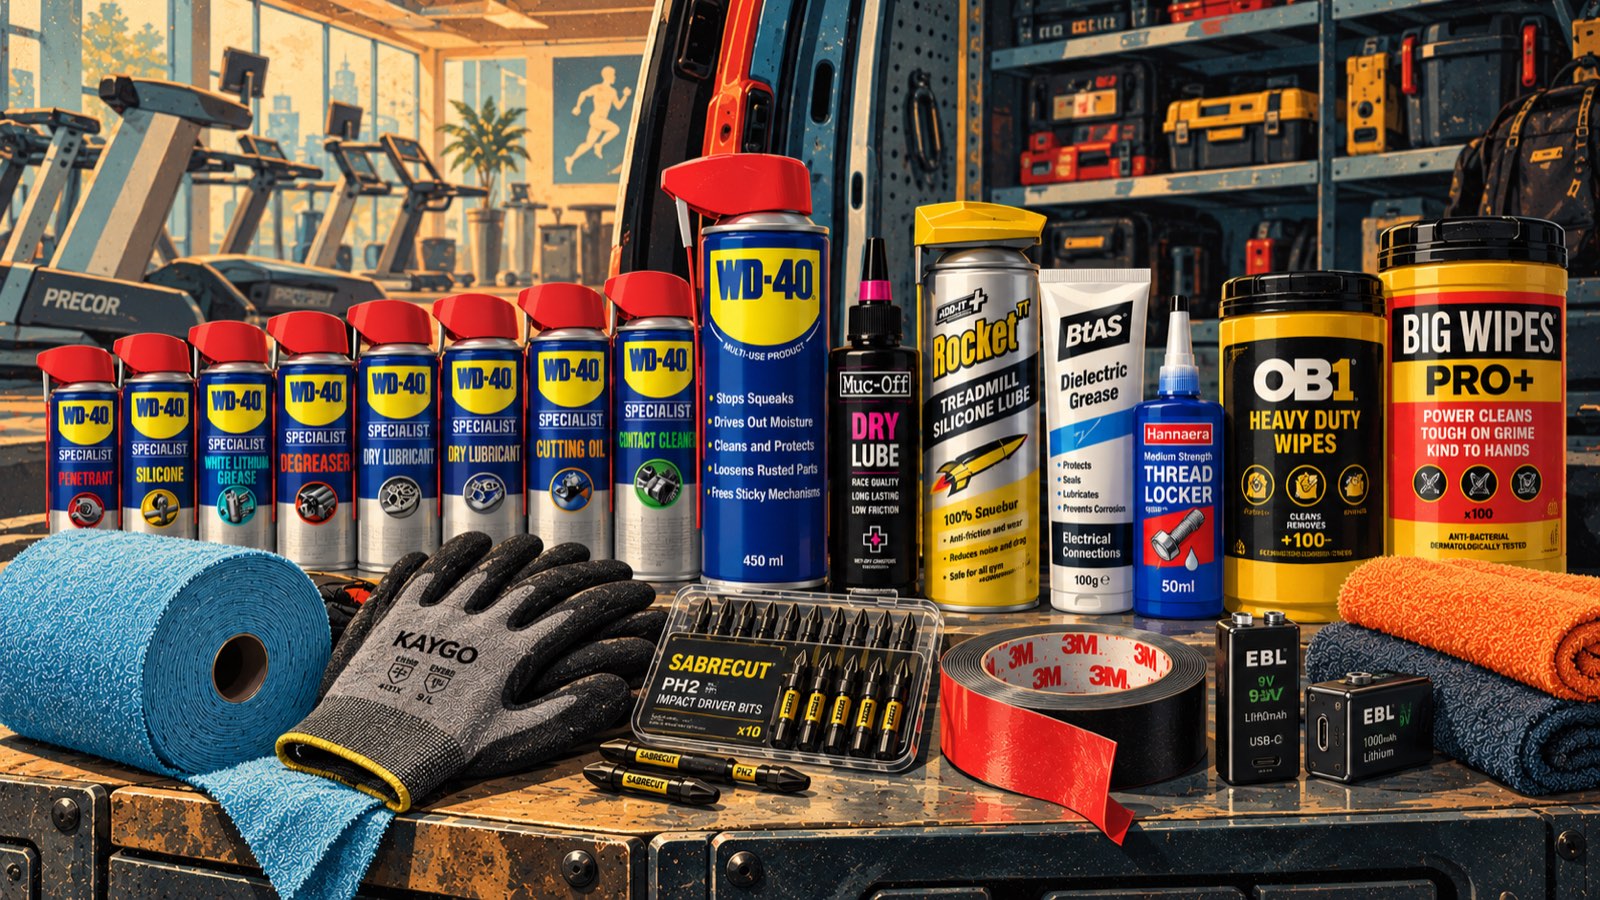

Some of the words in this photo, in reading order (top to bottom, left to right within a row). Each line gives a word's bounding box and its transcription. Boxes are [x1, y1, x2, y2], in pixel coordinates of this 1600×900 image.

[716, 259, 813, 301] WD-40
[42, 287, 121, 316] PRECOR
[1065, 314, 1123, 349] BtAS
[1402, 311, 1451, 355] BIG
[1459, 310, 1554, 354] WIPES
[723, 341, 766, 362] MULTI-USE
[767, 341, 805, 361] PRODUCT
[933, 312, 1018, 382] Rocket
[629, 348, 687, 373] WD-40
[456, 367, 513, 390] WD-40
[543, 358, 600, 382] WD-40
[1060, 361, 1128, 392] Dielectric
[371, 372, 427, 395] WD-40
[842, 375, 909, 395] Muc-Off
[1253, 358, 1354, 402] OB1
[1426, 363, 1534, 396] PRO+
[211, 390, 262, 411] WD-40
[289, 381, 344, 403] WD-40
[716, 392, 745, 407] Stops
[747, 392, 794, 407] Squeaks
[940, 371, 1020, 414] TREADMILL
[1069, 387, 1119, 410] Grease
[62, 405, 110, 425] WD-40
[136, 397, 185, 418] WD-40
[624, 404, 692, 418] SPECIALIST
[933, 399, 995, 439] SILICONE
[998, 385, 1031, 412] LUBE
[1423, 408, 1475, 423] POWER
[1478, 408, 1533, 423] CLEANS
[452, 420, 516, 433] SPECIALIST
[538, 413, 603, 427] SPECIALIST
[714, 416, 744, 428] Drives
[747, 416, 767, 428] Out
[770, 416, 813, 428] Moisture
[852, 411, 899, 441] DRY
[1249, 410, 1309, 430] HEAVY
[1314, 410, 1361, 430] DUTY
[285, 431, 346, 444] SPECIALIST
[368, 424, 430, 437] SPECIALIST
[1147, 427, 1210, 441] Hannaera
[1420, 426, 1467, 440] TOUGH
[1470, 426, 1491, 440] ON
[1494, 426, 1535, 440] GRIME
[132, 443, 188, 455] SPECIALIST
[208, 437, 265, 450] SPECIALIST
[536, 439, 585, 459] CUTTING
[588, 439, 606, 459] OIL
[714, 439, 747, 452] Cleans
[750, 439, 771, 452] and
[774, 439, 815, 452] Protects
[1274, 433, 1337, 454] WIPES
[1426, 443, 1460, 457] KIND
[1462, 443, 1481, 457] TO
[1484, 443, 1530, 457] HANDS
[58, 449, 113, 461] SPECIALIST
[204, 455, 231, 470] WHITE
[233, 456, 269, 470] LITHIUM
[363, 448, 380, 465] DRY
[383, 448, 434, 465] LUBRICANT
[448, 445, 466, 463] DRY
[468, 445, 521, 463] LUBRICANT
[852, 443, 899, 468] LUBE
[1178, 451, 1213, 463] Strength
[280, 453, 351, 473] DEGREASER
[714, 463, 754, 476] Loosens
[757, 463, 794, 476] Rusted
[796, 463, 818, 475] Parts
[1062, 460, 1092, 470] Protects
[58, 471, 113, 486] PENETRANT
[136, 466, 184, 483] SILICONE
[217, 471, 257, 485] GREASE
[851, 477, 869, 487] RACE
[1062, 475, 1082, 484] Seals
[1144, 465, 1214, 483] THREAD
[711, 486, 734, 499] Frees
[735, 487, 766, 503] Sticky
[768, 486, 821, 500] Mechanisms
[871, 491, 900, 501] LASTING
[1062, 489, 1099, 499] Lubricates
[1144, 485, 1213, 504] LOCKER
[851, 505, 867, 515] LOW
[868, 505, 900, 515] FRICTION
[1062, 503, 1093, 513] Prevents
[1094, 503, 1126, 514] Corrosion
[1289, 512, 1322, 521] CLEANS
[1464, 507, 1493, 520] x100
[943, 509, 973, 526] 100%
[1286, 521, 1327, 530] REMOVES
[949, 528, 992, 543] Anti-friction
[993, 523, 1006, 534] and
[1062, 531, 1112, 544] Electrical
[1448, 532, 1509, 542] ANTI-BACTERIAL
[949, 550, 978, 562] Reduces
[1000, 540, 1012, 551] and
[1062, 547, 1121, 559] Connections
[1501, 541, 1527, 550] TESTED
[743, 554, 766, 567] 450
[768, 554, 784, 567] ml
[1074, 574, 1099, 588] 100g
[1161, 579, 1195, 593] 50ml
[392, 630, 478, 665] KAYGO
[1061, 633, 1098, 655] 3M
[1008, 641, 1034, 669] 3M
[1133, 642, 1157, 672] 3M
[1246, 649, 1287, 667] EBL
[668, 653, 772, 680] SABRECUT
[661, 676, 701, 694] PH2
[1032, 665, 1062, 690] 3M
[1089, 665, 1128, 690] 3M
[1257, 675, 1275, 687] 9V
[655, 693, 697, 708] IMPACT
[697, 698, 737, 712] DRIVER
[737, 702, 763, 716] BITS
[1363, 704, 1395, 725] EBL
[736, 725, 762, 738] x10
[1249, 734, 1283, 747] USB-C
[639, 750, 677, 765] SABRECUT
[1363, 748, 1394, 763] Lithium
[736, 766, 753, 777] PH2
[626, 774, 665, 790] SABRECUT
